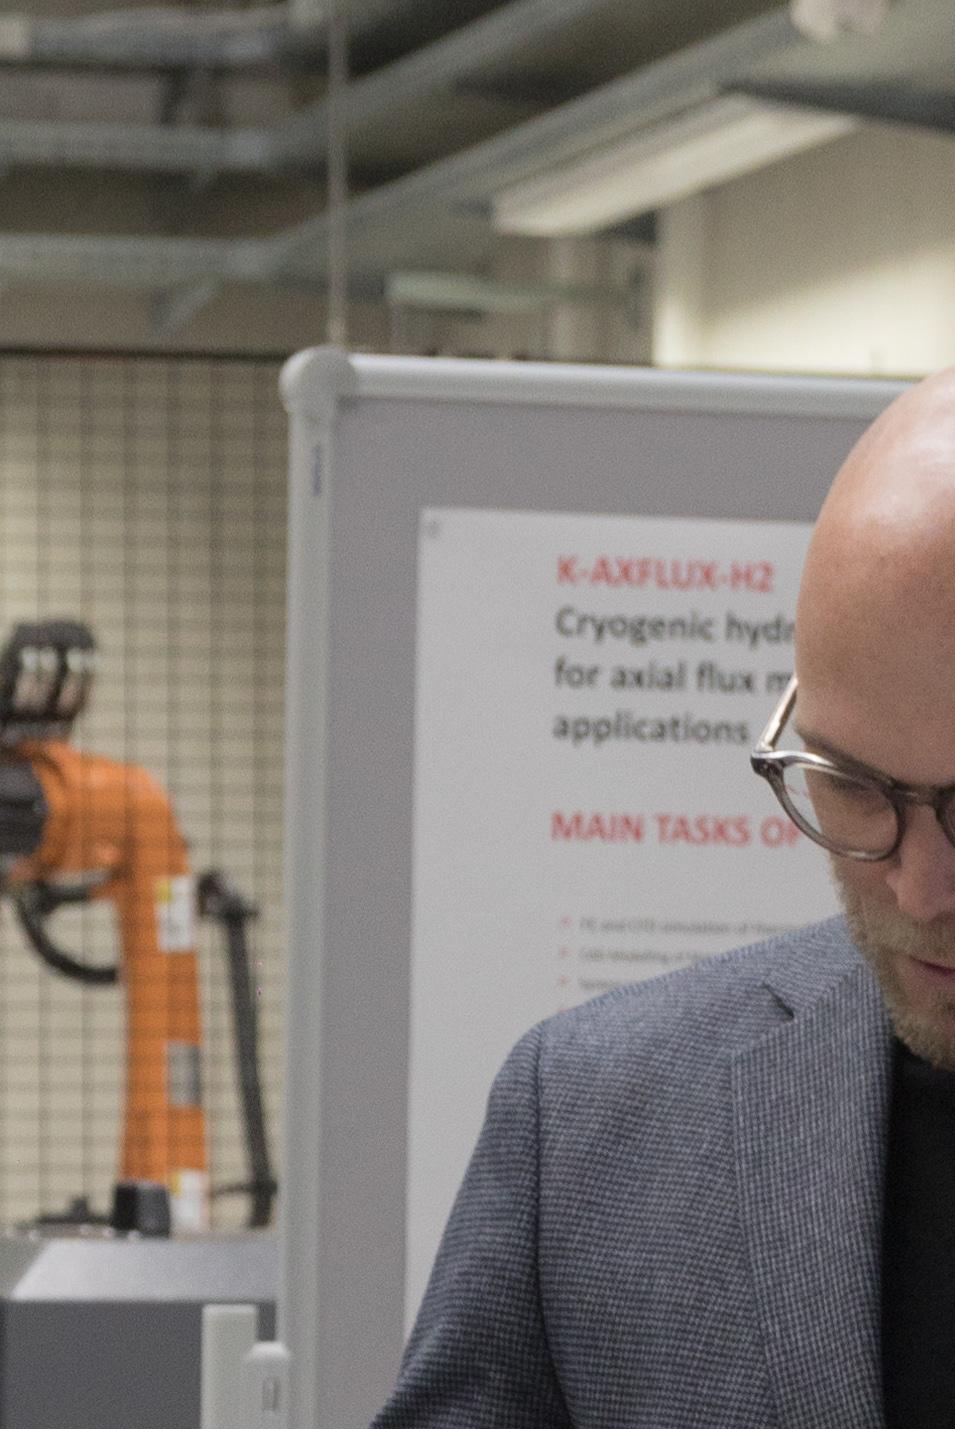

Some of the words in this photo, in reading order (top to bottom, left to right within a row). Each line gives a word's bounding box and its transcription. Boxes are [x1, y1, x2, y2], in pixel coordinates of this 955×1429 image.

[556, 555, 774, 593] K-AXFLUX-H2
[555, 606, 715, 645] Cryogenic
[555, 657, 600, 687] for
[611, 660, 687, 690] axial
[697, 661, 754, 692] flux
[553, 709, 750, 745] applications
[551, 812, 645, 842] MAIN
[655, 813, 750, 846] TASKS
